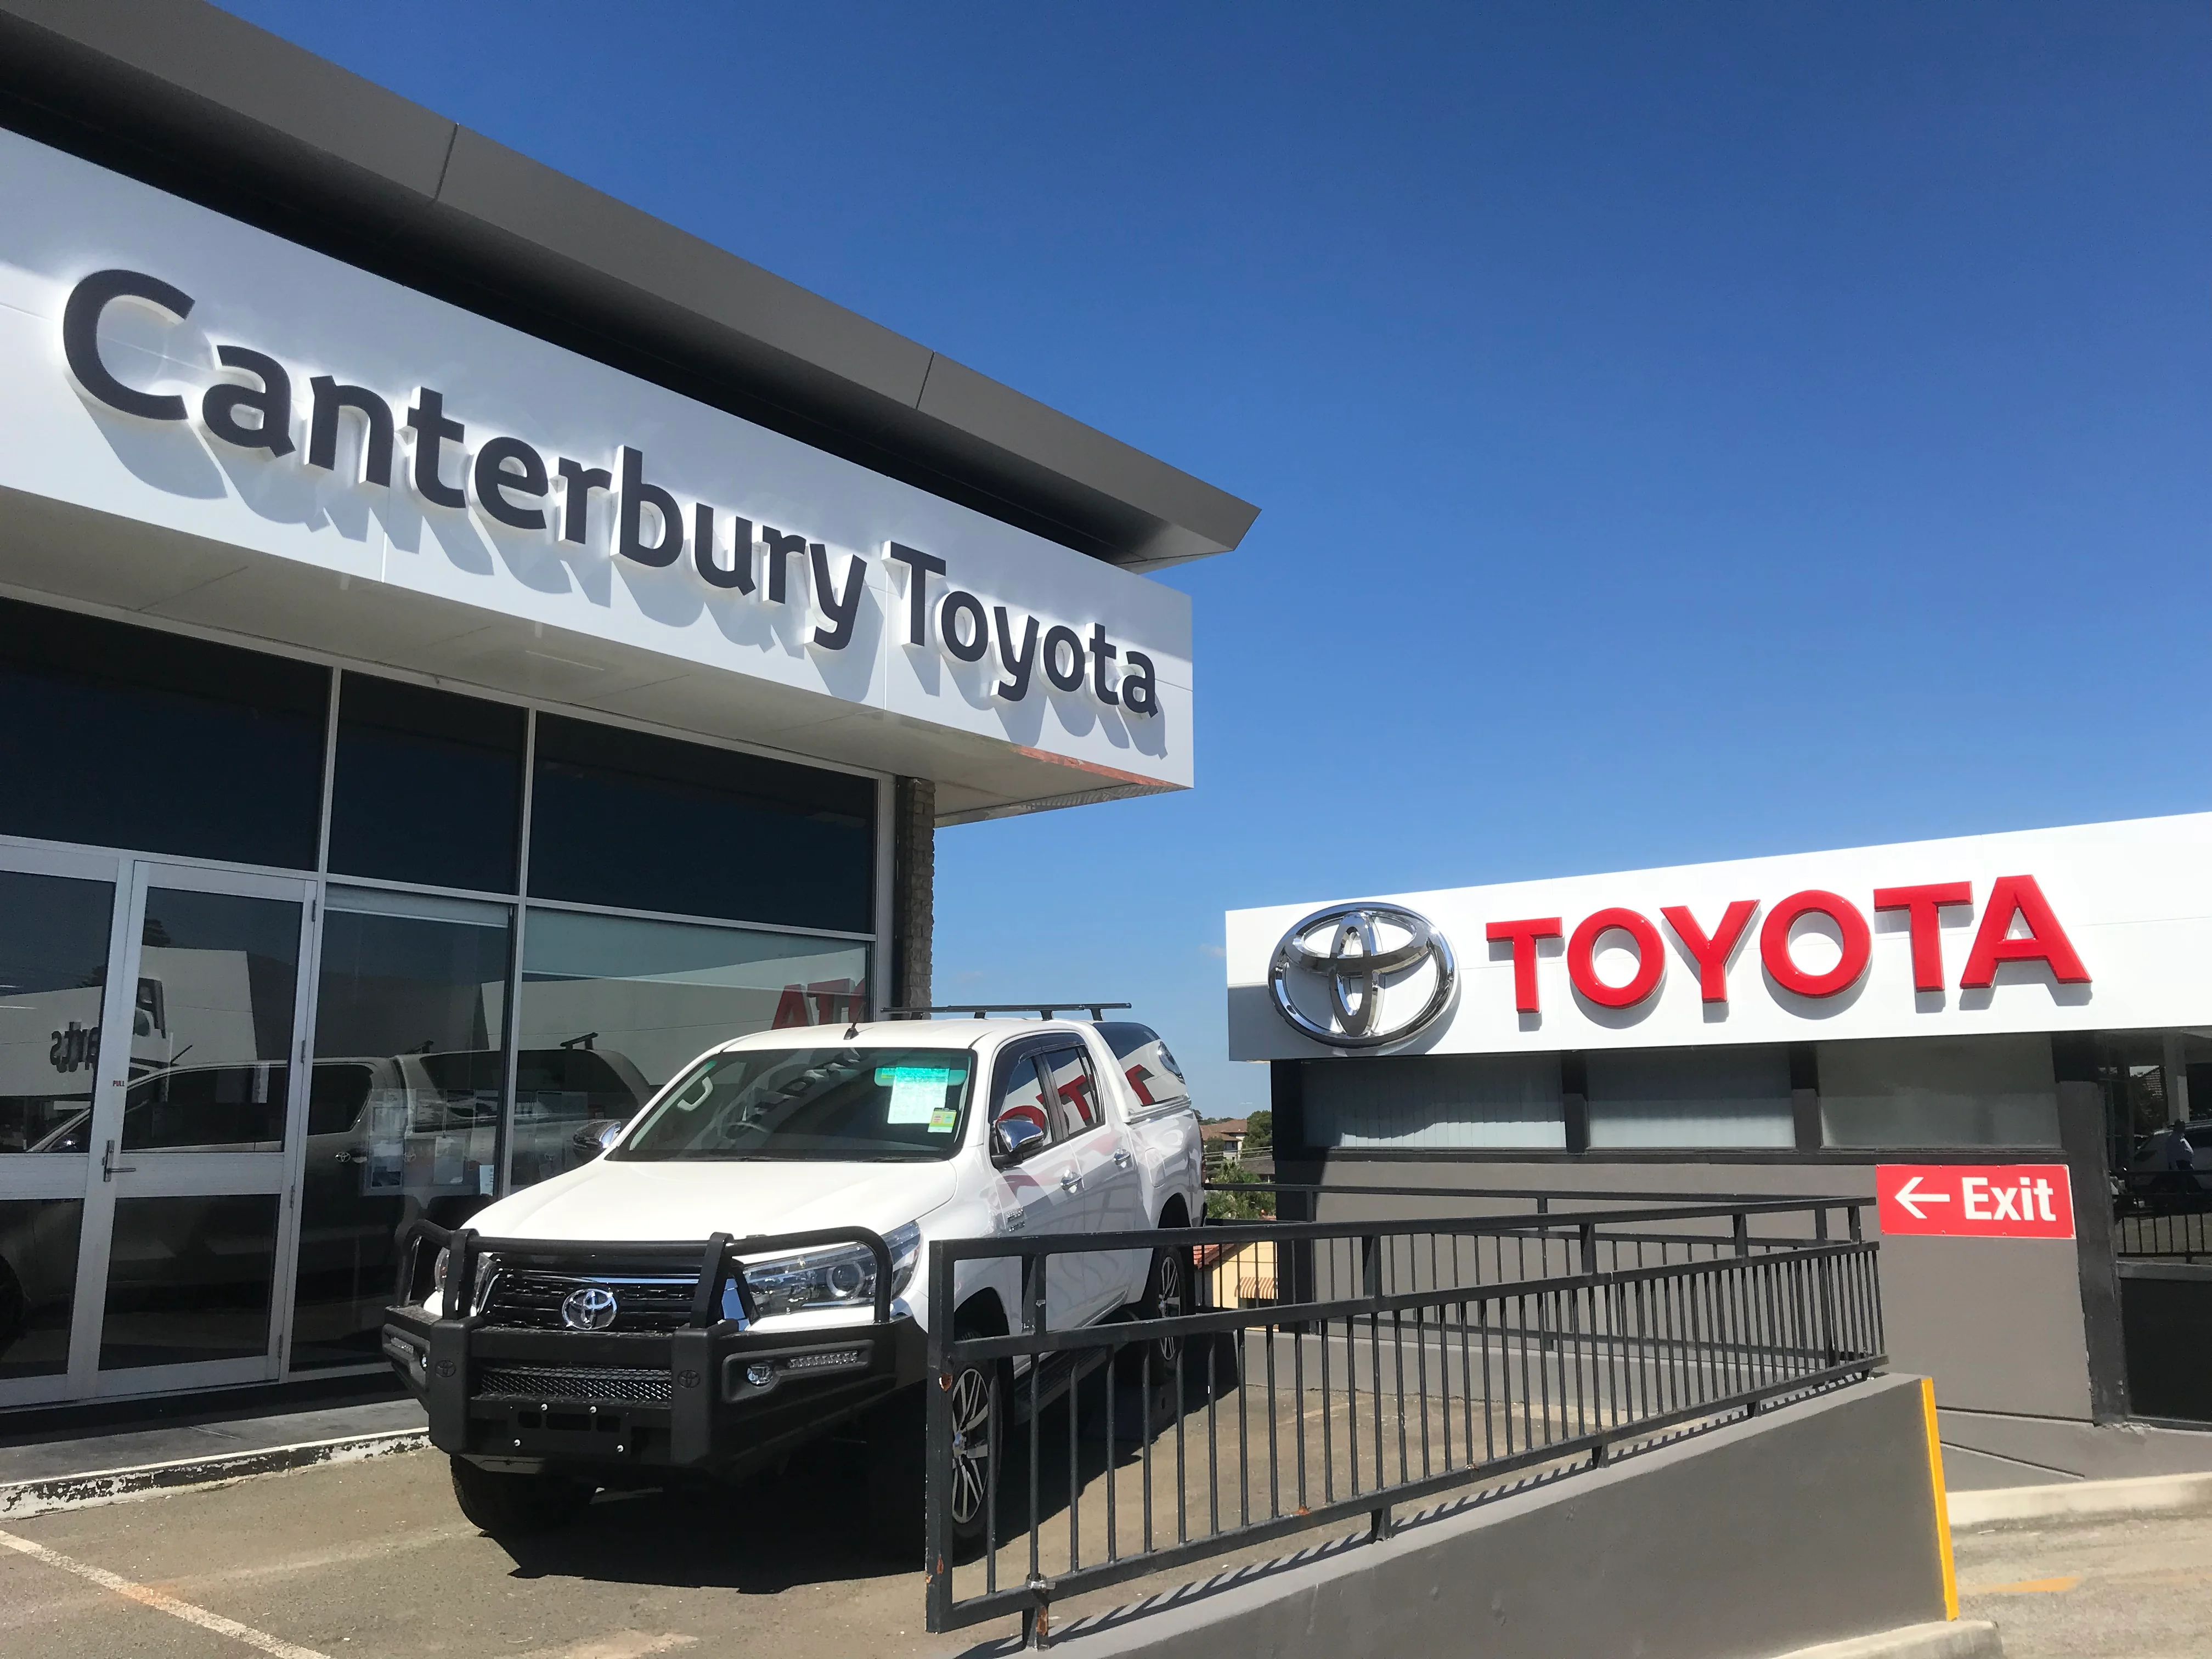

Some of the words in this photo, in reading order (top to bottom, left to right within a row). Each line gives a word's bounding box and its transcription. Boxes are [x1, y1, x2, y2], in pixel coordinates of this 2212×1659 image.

[63, 269, 867, 651] Canterbury
[889, 540, 1159, 718] Toyota
[1485, 874, 2091, 1013] TOYOTA
[1961, 1177, 2057, 1221] Exit
